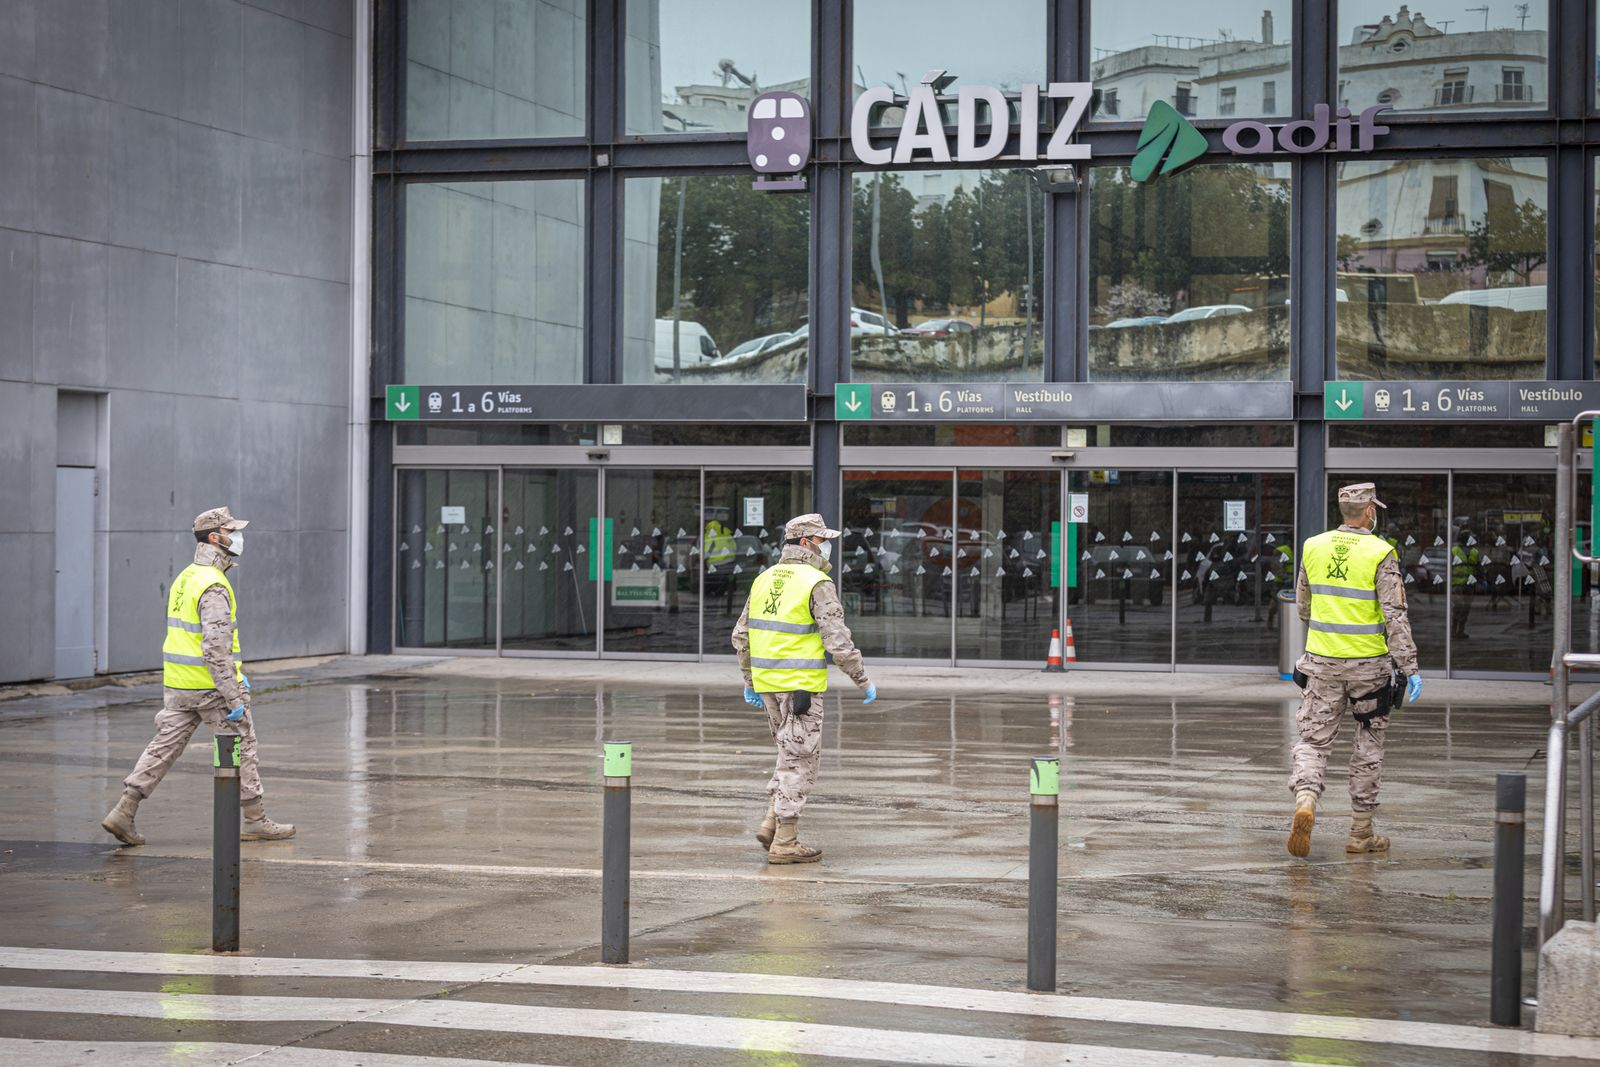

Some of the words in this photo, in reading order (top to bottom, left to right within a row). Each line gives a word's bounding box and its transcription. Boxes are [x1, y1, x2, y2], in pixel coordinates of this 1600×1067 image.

[849, 69, 1093, 165] CÁDIZ
[1221, 103, 1394, 155] adif
[451, 392, 464, 413] 1
[467, 403, 476, 413] a
[481, 391, 494, 413] 6
[498, 391, 521, 403] Vías
[906, 391, 920, 412] 1
[924, 402, 932, 412] a
[939, 390, 953, 413] 6
[957, 390, 982, 402] Vías
[1014, 390, 1072, 402] Vestíbulo
[1402, 389, 1416, 411] 1
[1421, 401, 1430, 411] a
[1437, 388, 1452, 412] 6
[1457, 388, 1484, 401] Vías
[1519, 388, 1583, 401] Vestíbulo
